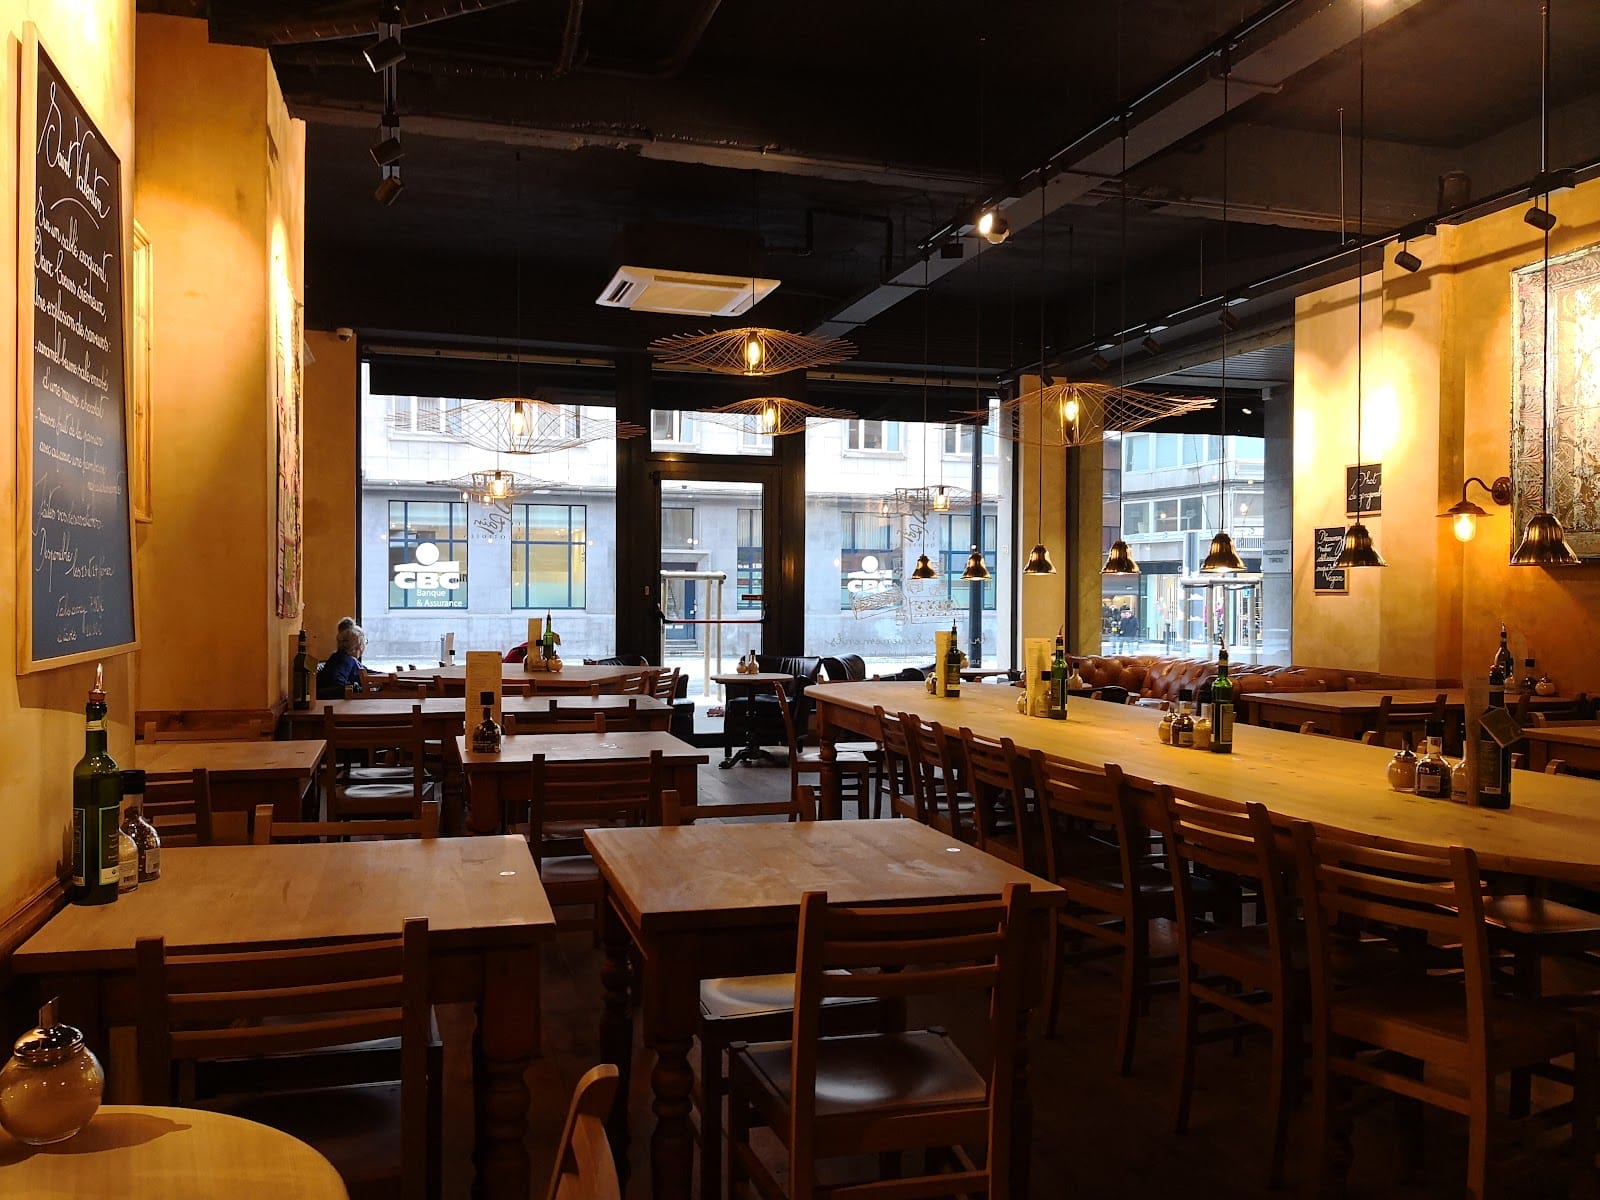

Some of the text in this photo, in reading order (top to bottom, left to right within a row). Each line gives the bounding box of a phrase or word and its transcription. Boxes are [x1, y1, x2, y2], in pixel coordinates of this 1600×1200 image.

[38, 81, 110, 218] Saint Valentin
[394, 572, 460, 590] CBC
[847, 580, 893, 593] CBC
[417, 590, 446, 598] Banque
